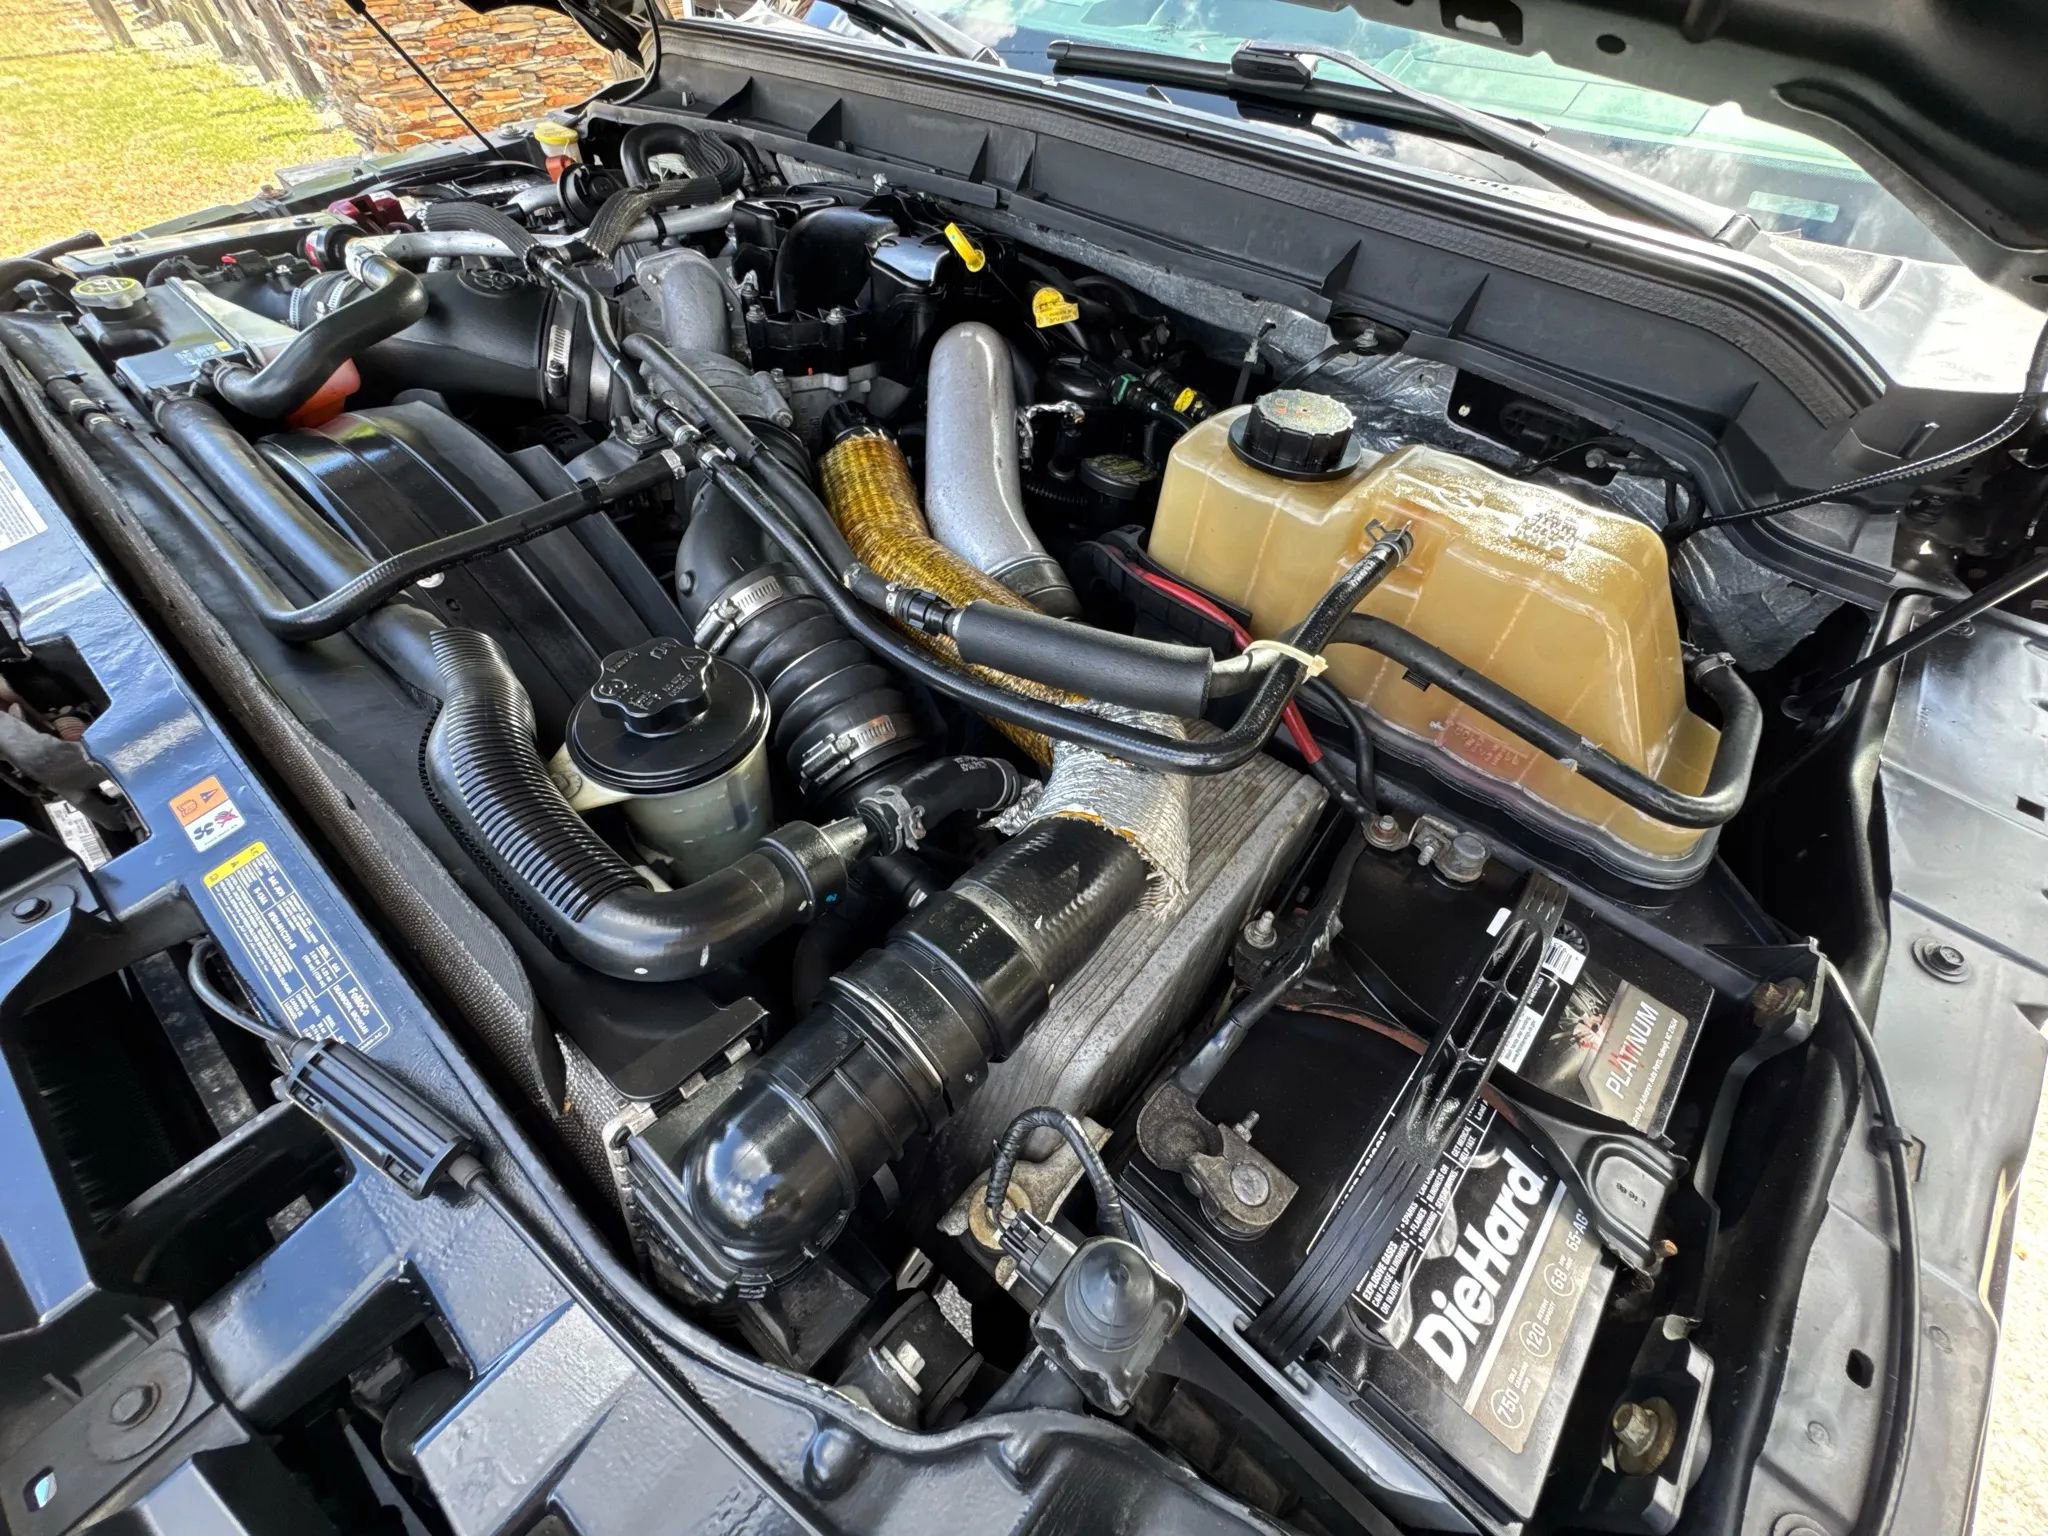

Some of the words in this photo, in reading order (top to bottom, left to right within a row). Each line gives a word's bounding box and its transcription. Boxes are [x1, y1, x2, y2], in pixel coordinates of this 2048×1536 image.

[347, 986, 372, 1017] FoMoCo
[1605, 1000, 1659, 1099] PLATINUM
[1450, 1144, 1461, 1158] GET
[1455, 1124, 1472, 1148] MEDICAL
[1458, 1147, 1470, 1163] HELP
[1464, 1133, 1477, 1150] FAST.
[1424, 1171, 1445, 1202] BLINDNESS
[1438, 1162, 1449, 1175] OR
[1400, 1200, 1419, 1225] SPARKS
[1409, 1206, 1427, 1232] FLAMES
[1418, 1209, 1438, 1240] SMOKING
[1360, 1260, 1388, 1301] EXPLOSIVE
[1379, 1239, 1399, 1265] GASES
[1387, 1239, 1410, 1275] BLINDNESS
[1410, 1146, 1547, 1384] DieHard
[1377, 1270, 1394, 1295] CAUSE
[1384, 1278, 1403, 1305] INJURY.
[1549, 1266, 1568, 1290] 68
[1371, 1290, 1384, 1308] CAN
[1379, 1301, 1391, 1315] OR
[1525, 1320, 1547, 1351] 120
[1497, 1386, 1522, 1422] 750
